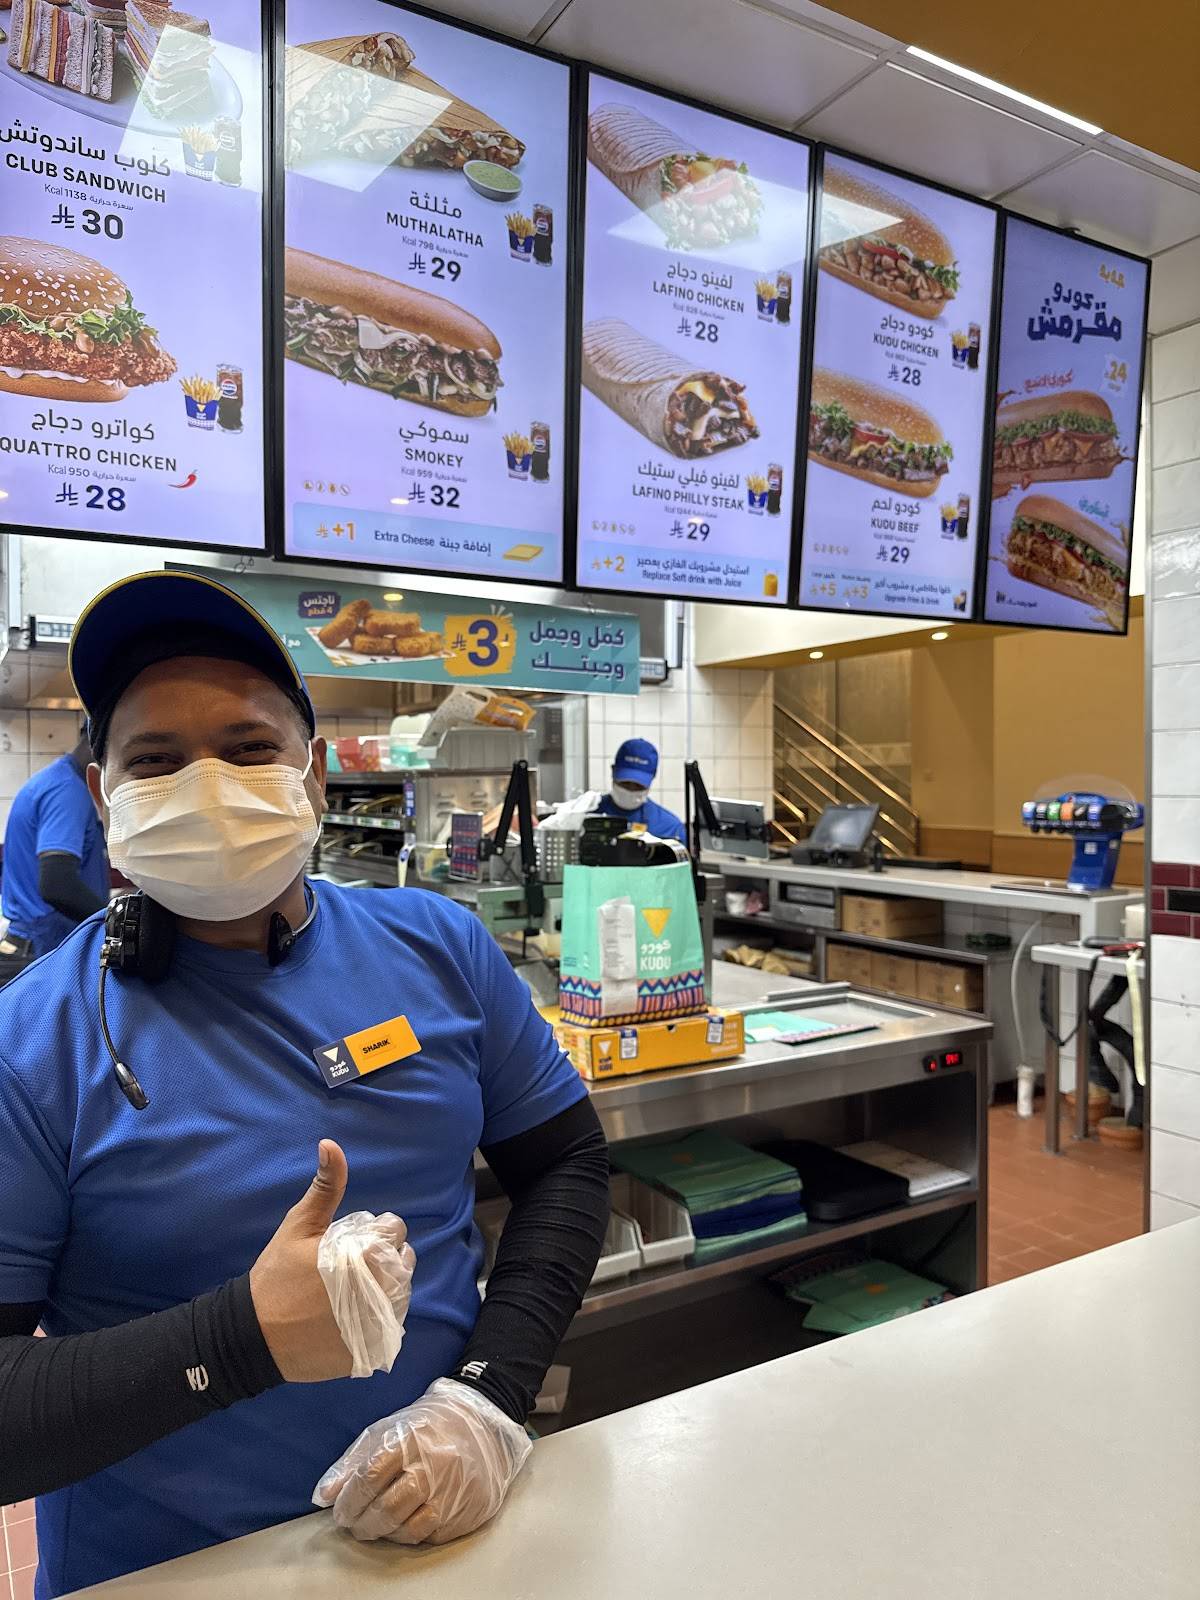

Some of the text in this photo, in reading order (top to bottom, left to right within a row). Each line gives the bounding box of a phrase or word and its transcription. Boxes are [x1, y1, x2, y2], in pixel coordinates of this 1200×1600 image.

[114, 152, 171, 177] كلوب
[6, 153, 166, 203] CLUB SANDWICH
[44, 184, 87, 201] Kcal 1138
[409, 190, 462, 219] مثلثة
[82, 209, 124, 240] 30
[386, 212, 484, 248] MUTHALATHA
[402, 235, 434, 250] Kcal 798
[431, 257, 461, 282] 29
[667, 262, 697, 282] دجاج
[653, 281, 694, 301] LAFINO
[697, 292, 744, 313] CHICKEN
[1052, 282, 1094, 311] كودو
[695, 321, 719, 343] 28
[880, 314, 934, 340] كودو دجاج
[1027, 298, 1122, 344] مقرمش
[873, 333, 938, 358] KUDU CHICKEN
[902, 366, 921, 386] 28
[1110, 361, 1127, 383] 24
[31, 409, 155, 444] كواترو دجاج
[399, 421, 469, 444] سموكي
[0, 436, 177, 472] QUATTRO CHICKEN
[405, 448, 464, 468] SMOKEY
[47, 463, 90, 478] Kcal 950
[86, 484, 126, 512] 28
[430, 485, 460, 508] 32
[632, 485, 744, 511] LAFINO PHILLY STEAK
[332, 523, 356, 541] +1
[687, 522, 710, 542] 29
[871, 518, 919, 533] KUDU BEEF
[374, 530, 435, 547] Extra Cheese
[439, 538, 492, 557] إضافة جبنة
[604, 556, 625, 572] +2
[890, 546, 910, 564] 29
[672, 572, 686, 583] Soft
[468, 619, 499, 667] 3
[640, 956, 671, 971] KUDU
[362, 1038, 390, 1054] SHARIK
[332, 1066, 349, 1078] KUDU
